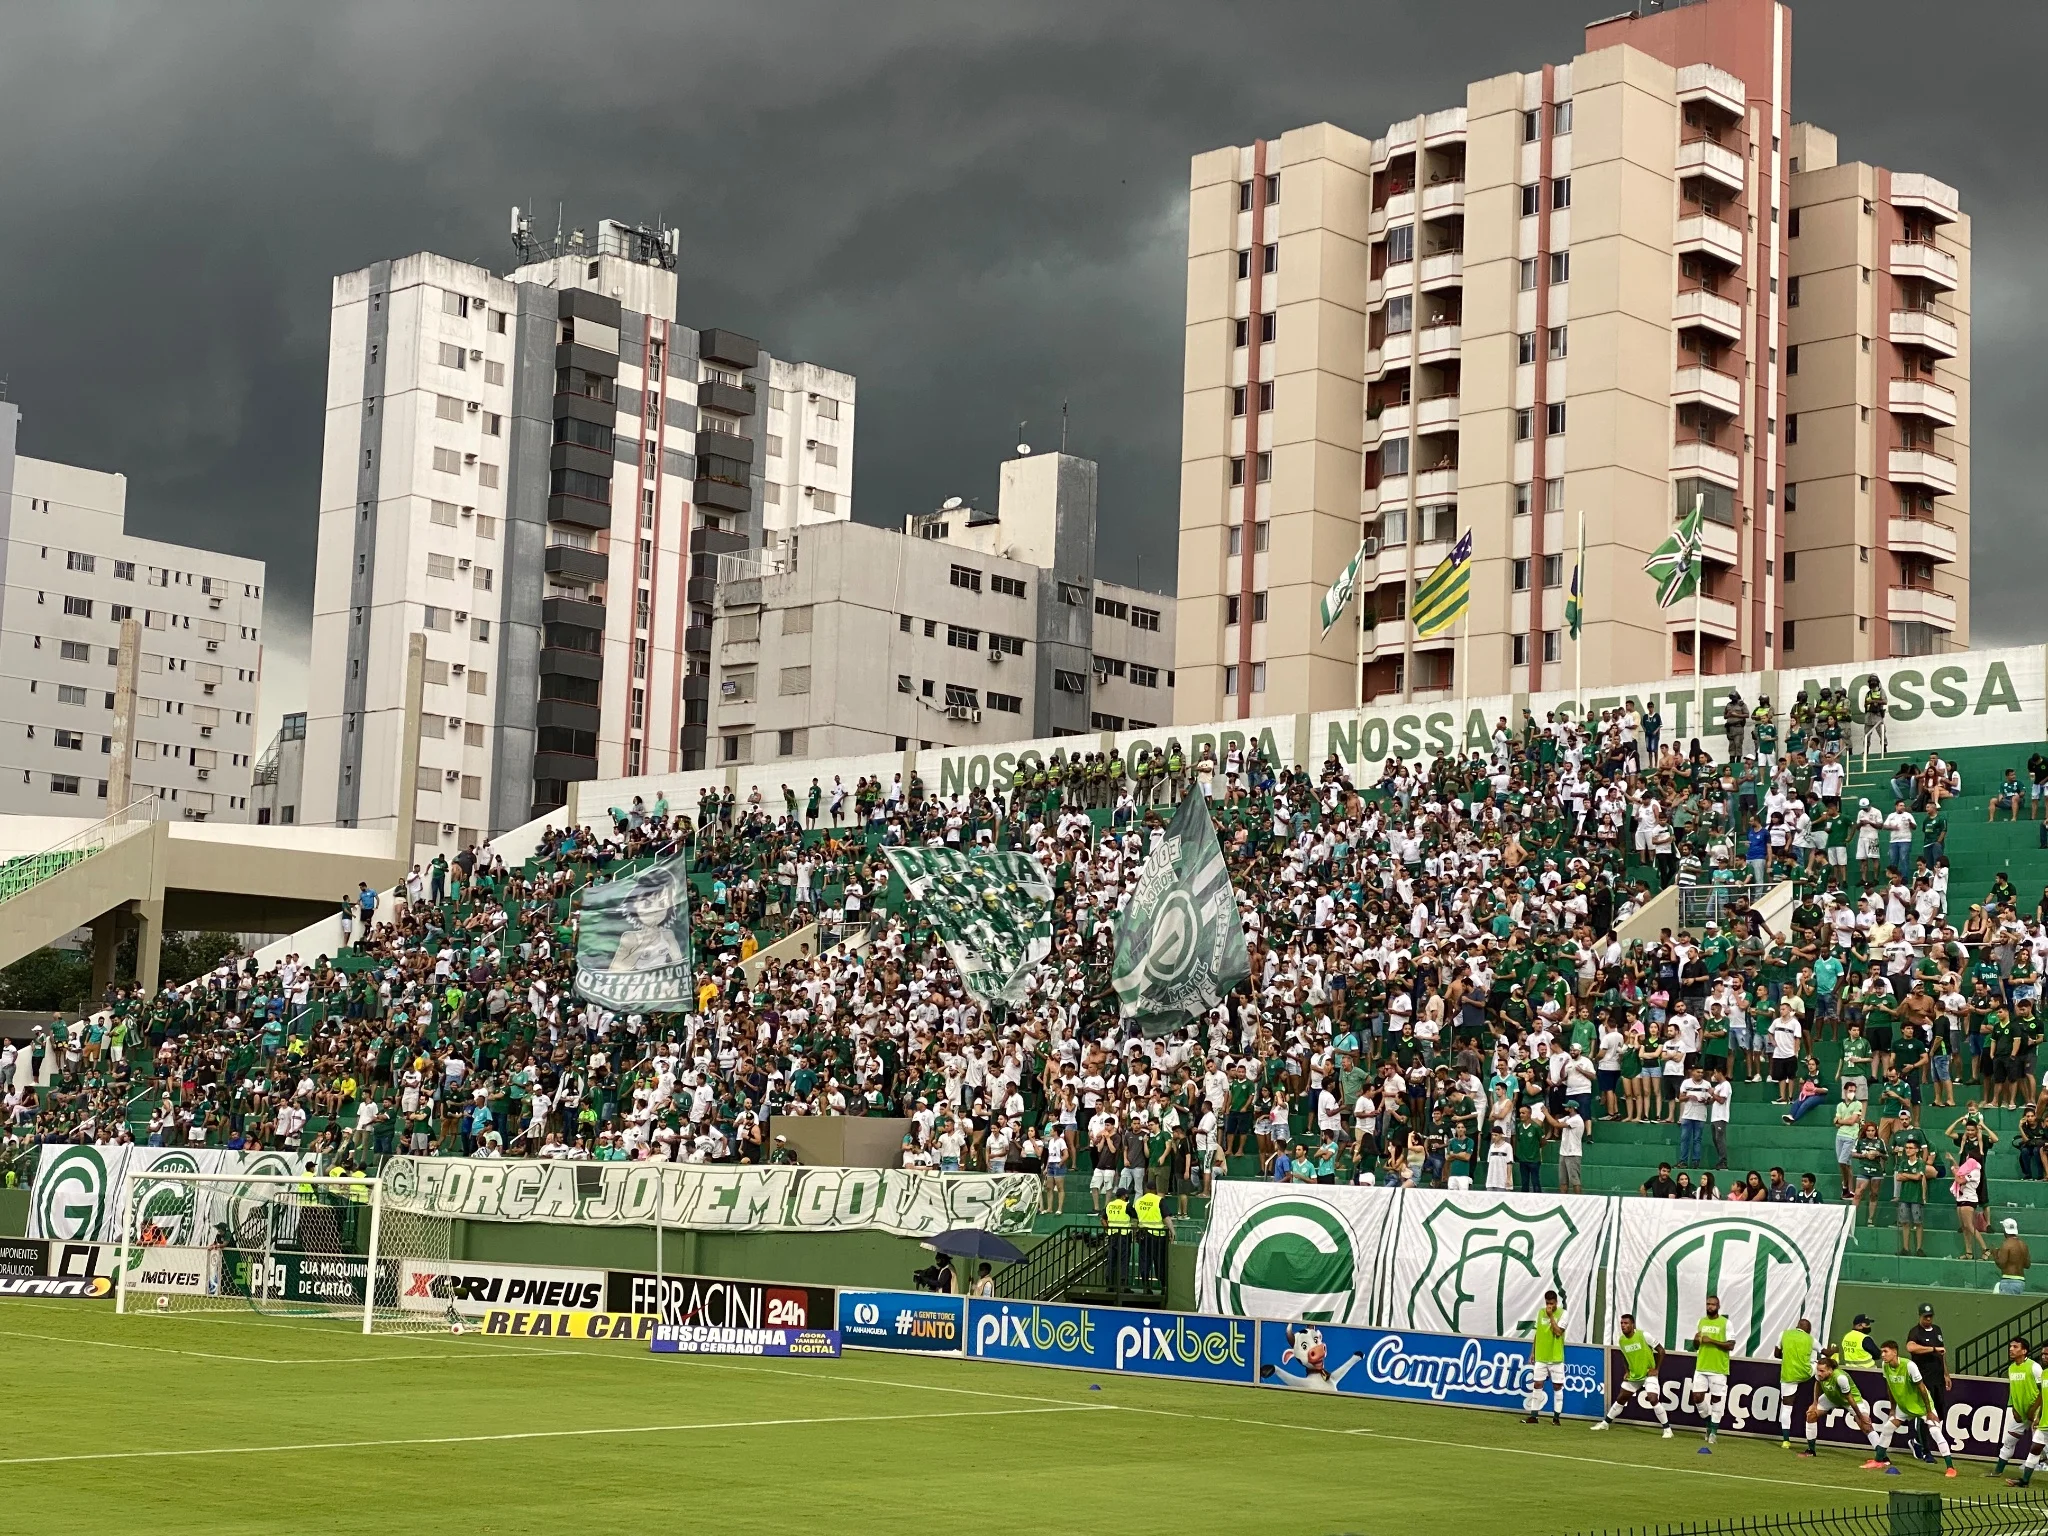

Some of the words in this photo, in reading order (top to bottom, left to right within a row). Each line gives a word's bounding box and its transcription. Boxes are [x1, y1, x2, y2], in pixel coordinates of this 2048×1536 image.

[1328, 708, 1494, 765] NOSSA
[416, 1162, 577, 1219] FORÇA
[586, 1167, 792, 1225] JOVEM
[797, 1168, 996, 1231] GOIÁS
[141, 1268, 201, 1286] IMÓVEIS
[299, 1260, 320, 1275] SUA
[298, 1280, 312, 1295] DE
[313, 1280, 352, 1297] CARTÃO
[504, 1279, 603, 1309] PNEUS
[632, 1277, 763, 1330] FERRACINI
[767, 1298, 805, 1327] 24h
[913, 1310, 919, 1318] A
[919, 1311, 937, 1320] GENTE
[937, 1311, 956, 1321] TORCE
[486, 1311, 571, 1337] REAL
[586, 1313, 661, 1340] CAP
[845, 1325, 852, 1333] TV
[852, 1326, 888, 1336] ANHANGUERA
[976, 1305, 1095, 1356] pixbet
[656, 1325, 787, 1346] RISCADINHA
[1116, 1316, 1246, 1370] pixbet
[678, 1341, 695, 1352] DO
[697, 1342, 764, 1355] CERRADO
[790, 1344, 836, 1354] DIGITAL
[1563, 1363, 1596, 1376] omos
